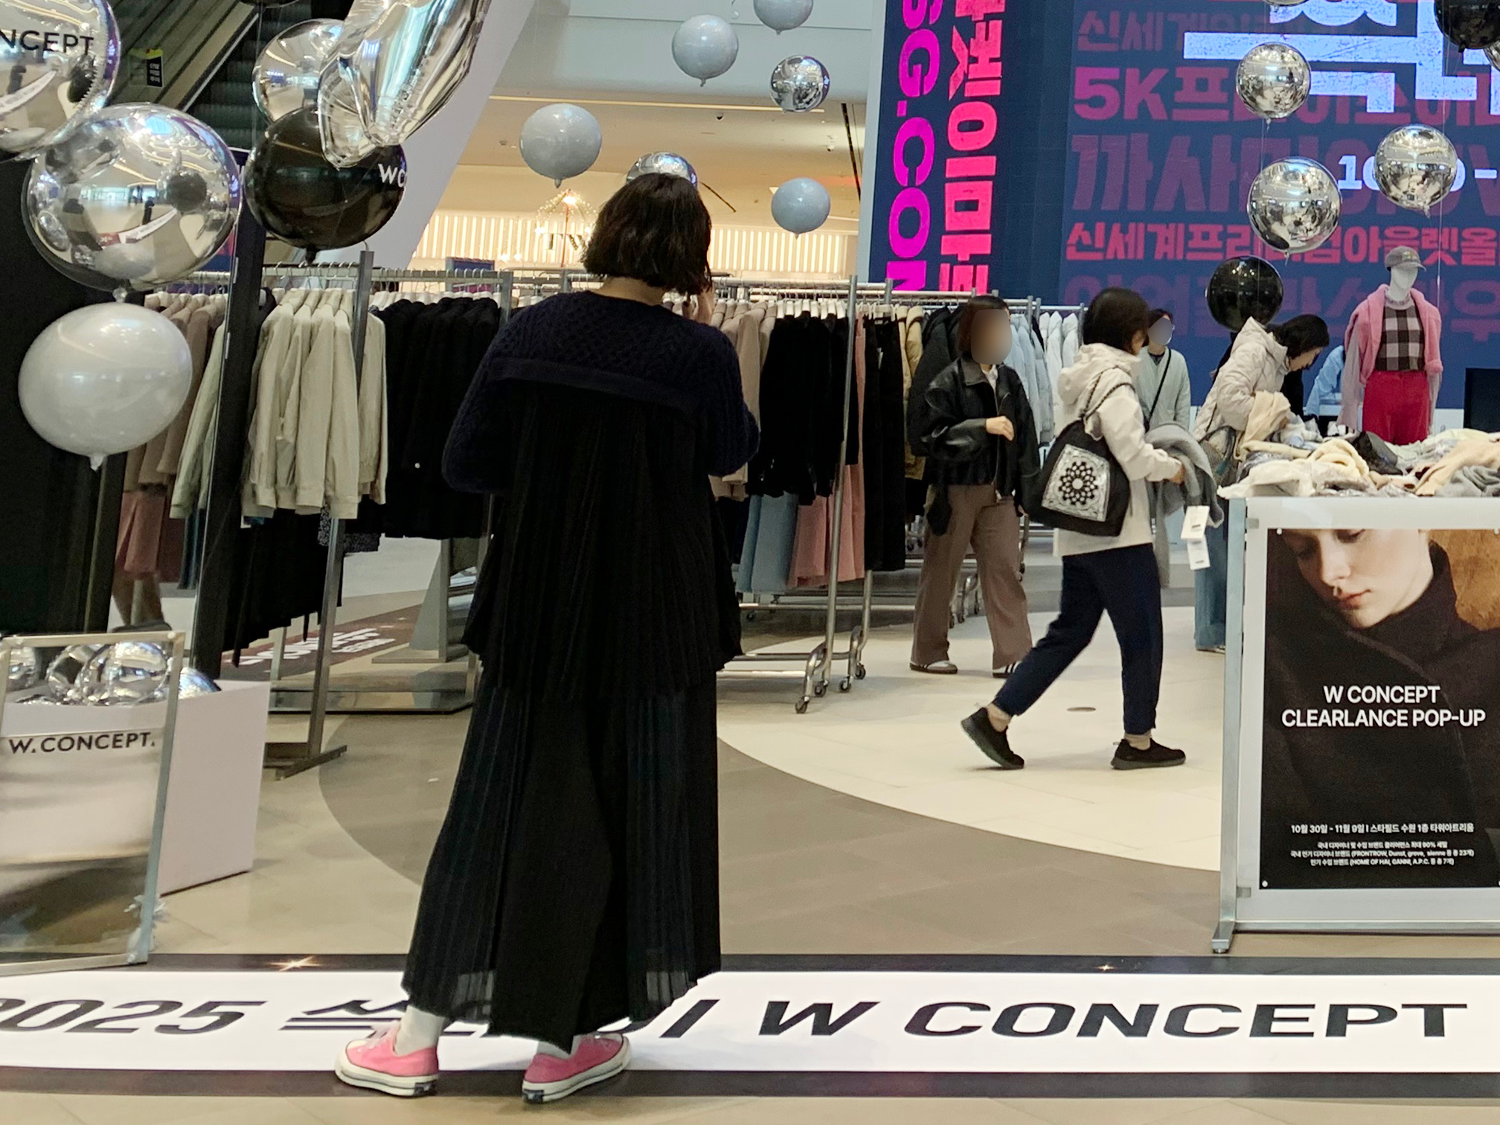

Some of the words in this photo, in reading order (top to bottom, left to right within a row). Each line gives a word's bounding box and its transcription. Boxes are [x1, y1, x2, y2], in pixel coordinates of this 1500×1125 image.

[1323, 685, 1344, 704] W
[1347, 685, 1440, 704] CONCEPT
[1281, 709, 1409, 728] CLEARLANCE
[1412, 708, 1486, 728] POP-UP
[1291, 823, 1308, 834] 10월
[1310, 823, 1328, 834] 30일
[1335, 823, 1350, 834] 11월
[1352, 823, 1364, 833] 9일
[1370, 823, 1400, 833] 스타필드
[1401, 823, 1416, 833] 수원
[758, 1000, 881, 1036] W
[902, 1001, 1469, 1038] CONCEPT
